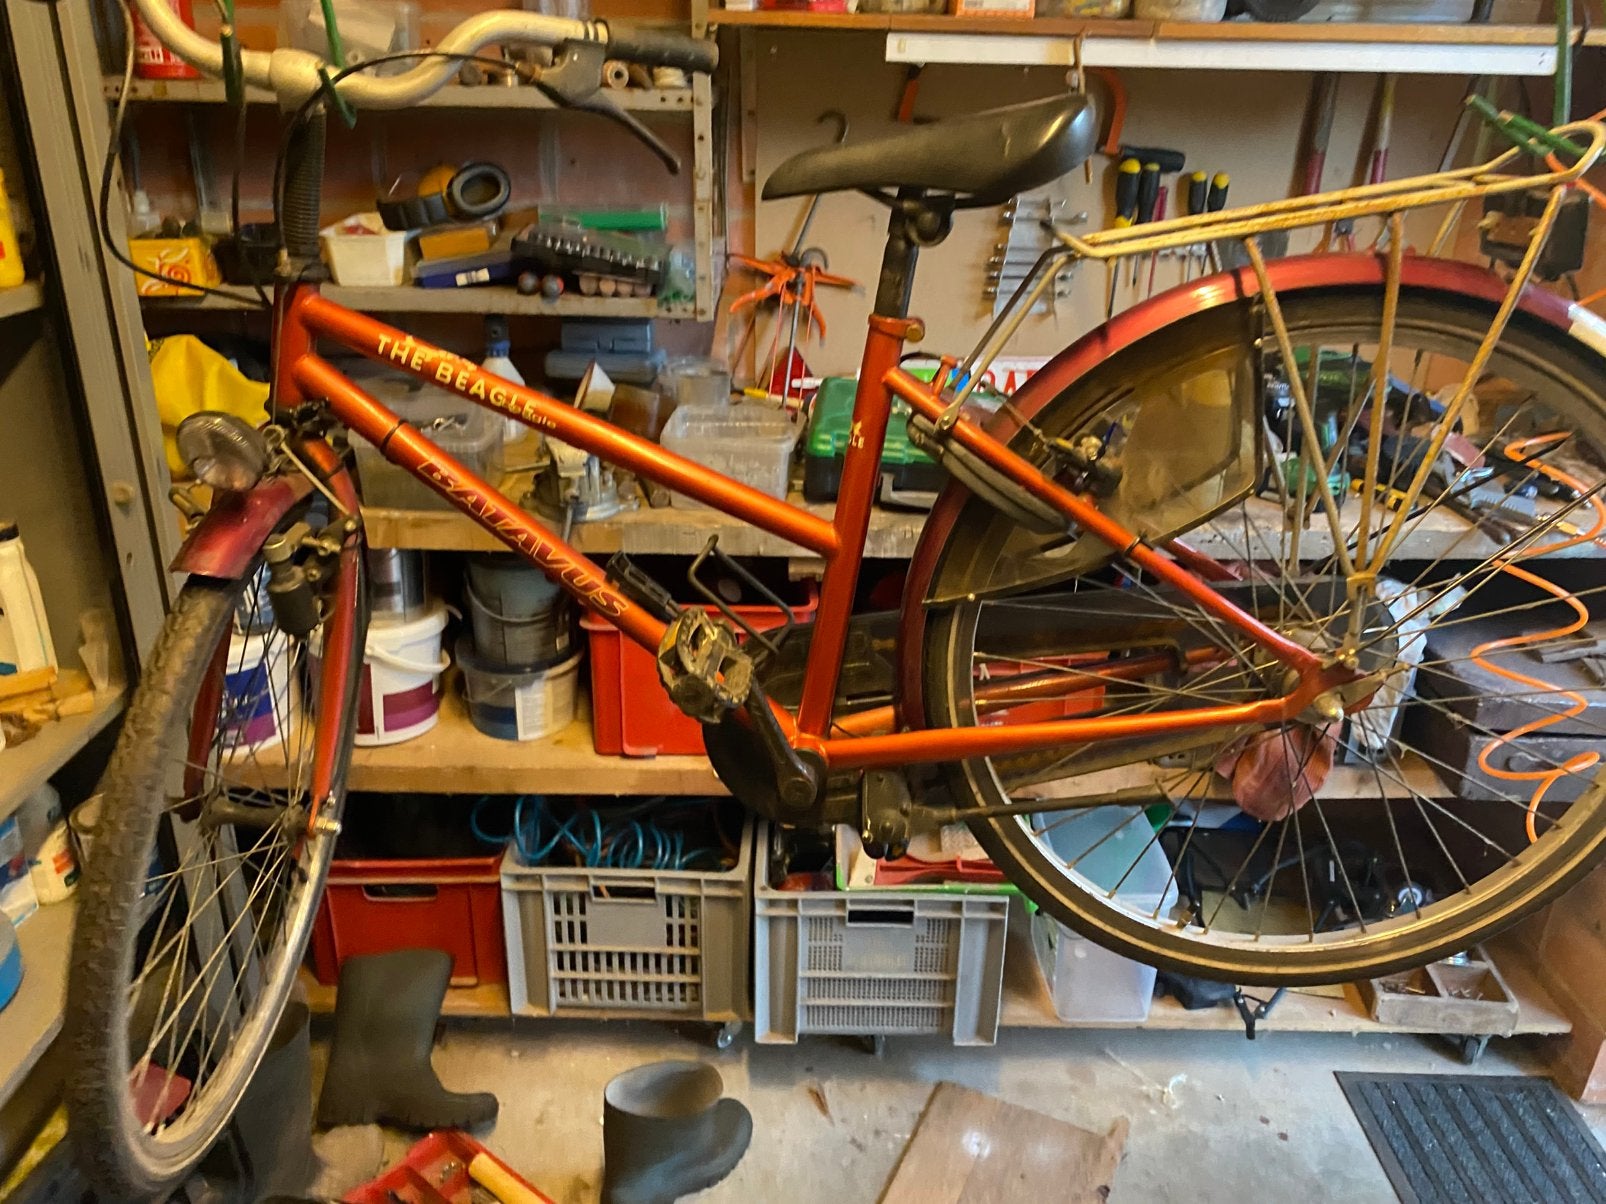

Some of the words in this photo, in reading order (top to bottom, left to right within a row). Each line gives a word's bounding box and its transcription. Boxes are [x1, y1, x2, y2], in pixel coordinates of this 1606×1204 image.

[378, 334, 423, 371] THE
[435, 361, 537, 420] BEAGLE
[417, 459, 629, 617] BATAVUS
